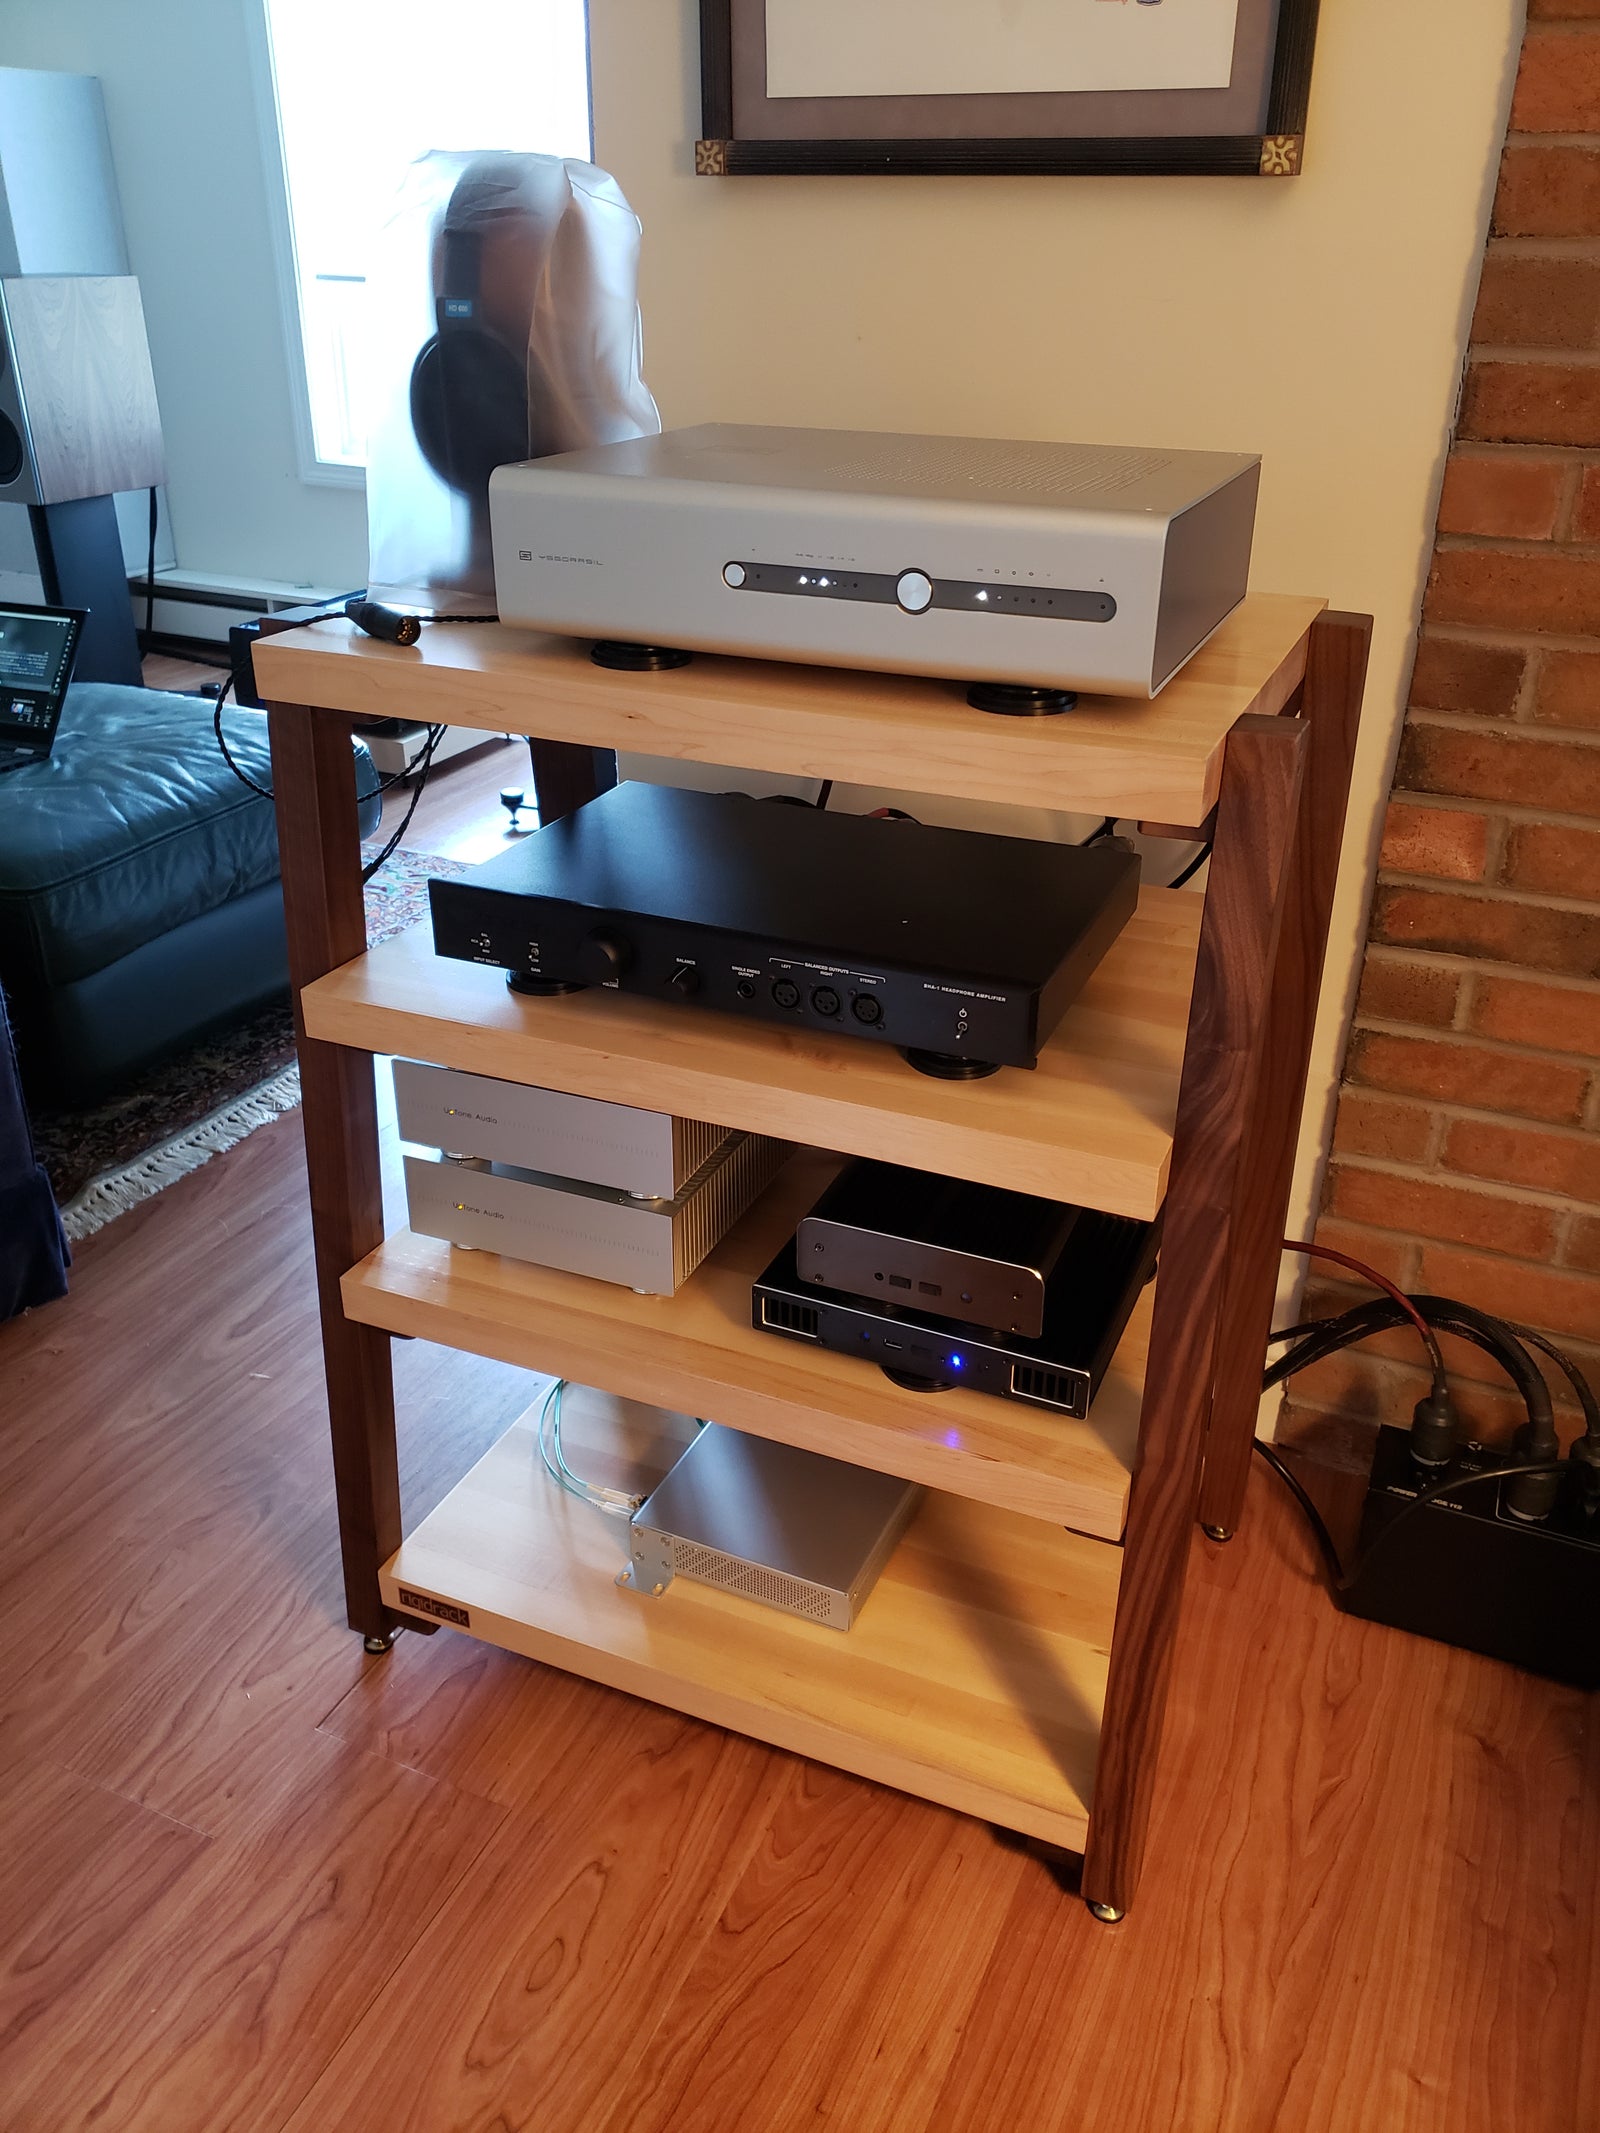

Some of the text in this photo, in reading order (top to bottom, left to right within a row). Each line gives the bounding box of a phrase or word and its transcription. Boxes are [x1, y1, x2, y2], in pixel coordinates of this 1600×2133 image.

[676, 957, 697, 966] BALANCE
[804, 962, 849, 975] BALANCED OUTPUTS
[859, 977, 877, 985] STEREO
[923, 983, 1006, 1003] BHA-1 HEADPHONE AMPLIFIER
[443, 1107, 498, 1124] UTone Audio
[452, 1201, 505, 1220] UTone Audio
